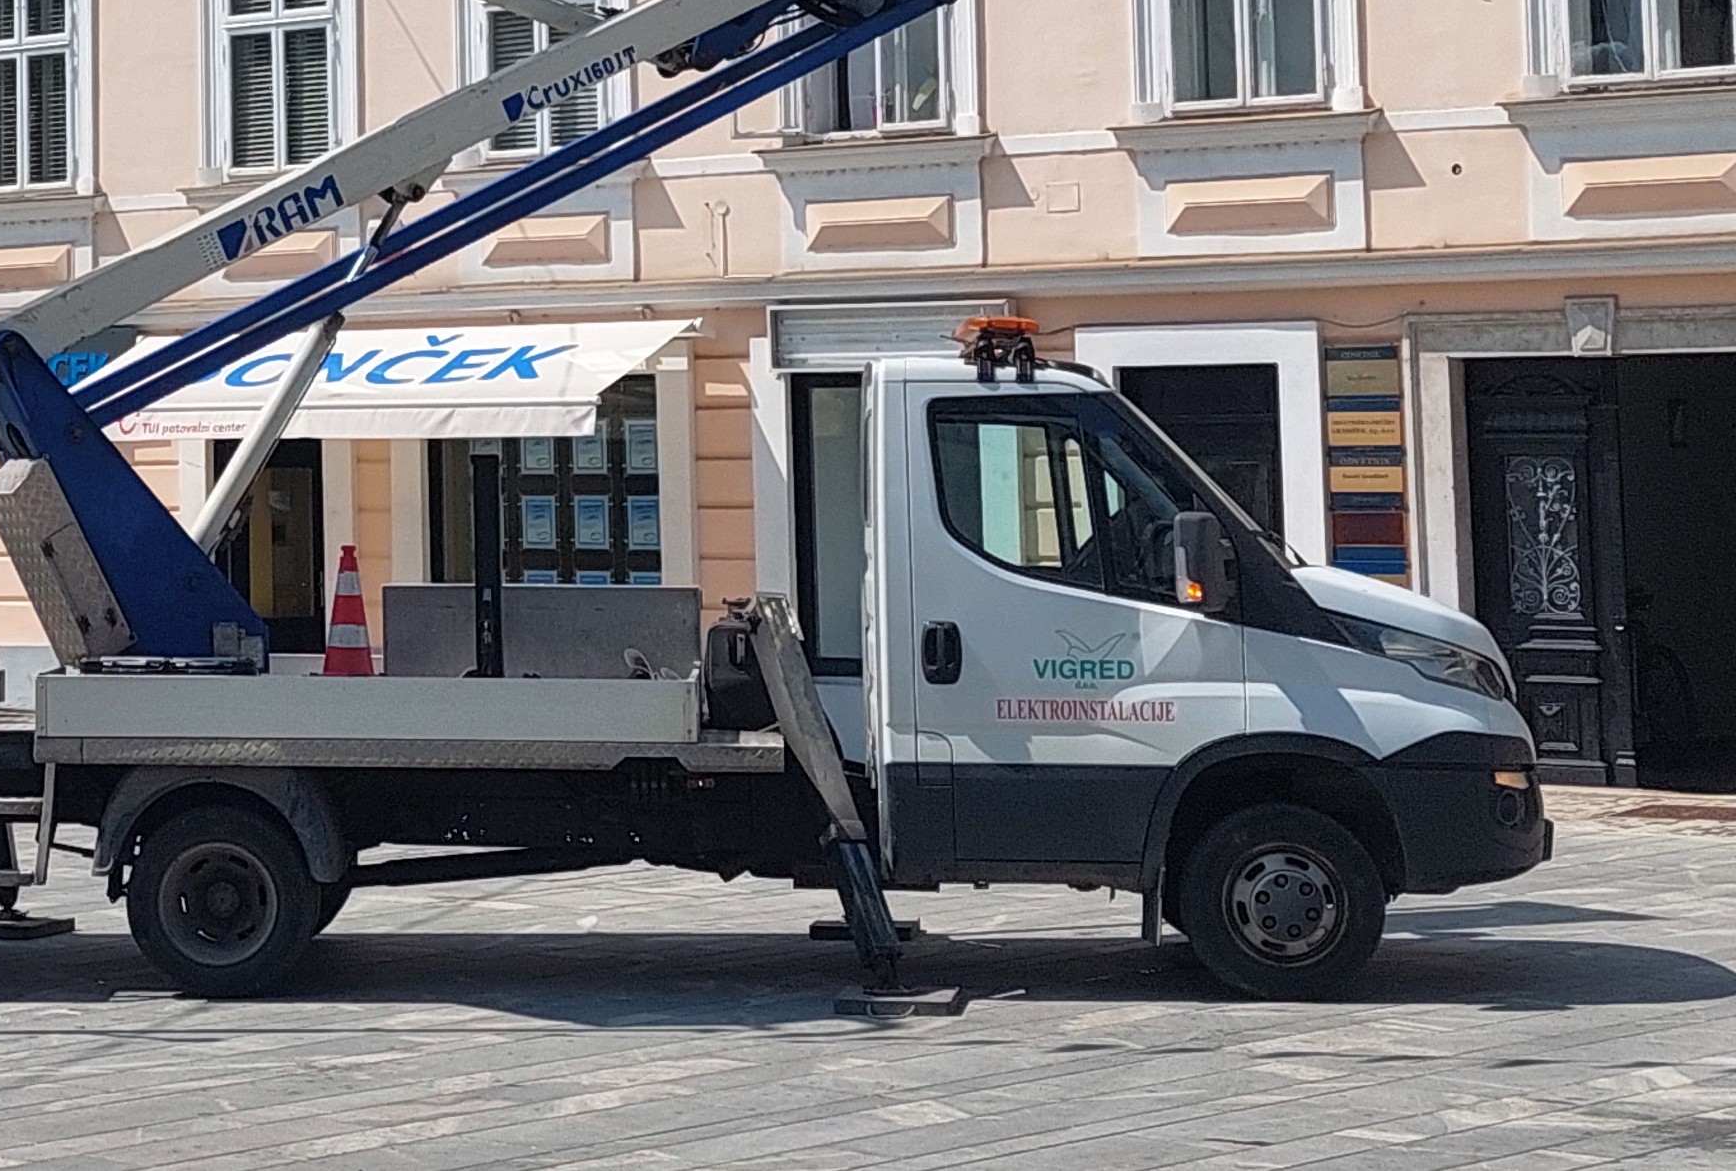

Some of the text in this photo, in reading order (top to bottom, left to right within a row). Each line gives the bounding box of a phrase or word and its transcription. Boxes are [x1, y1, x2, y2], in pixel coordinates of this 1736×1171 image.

[252, 173, 346, 246] RAM
[142, 422, 160, 435] TUI
[213, 422, 247, 433] center
[1033, 658, 1135, 680] VIGRED
[997, 699, 1175, 722] ELEKTROINSTALACIJE
